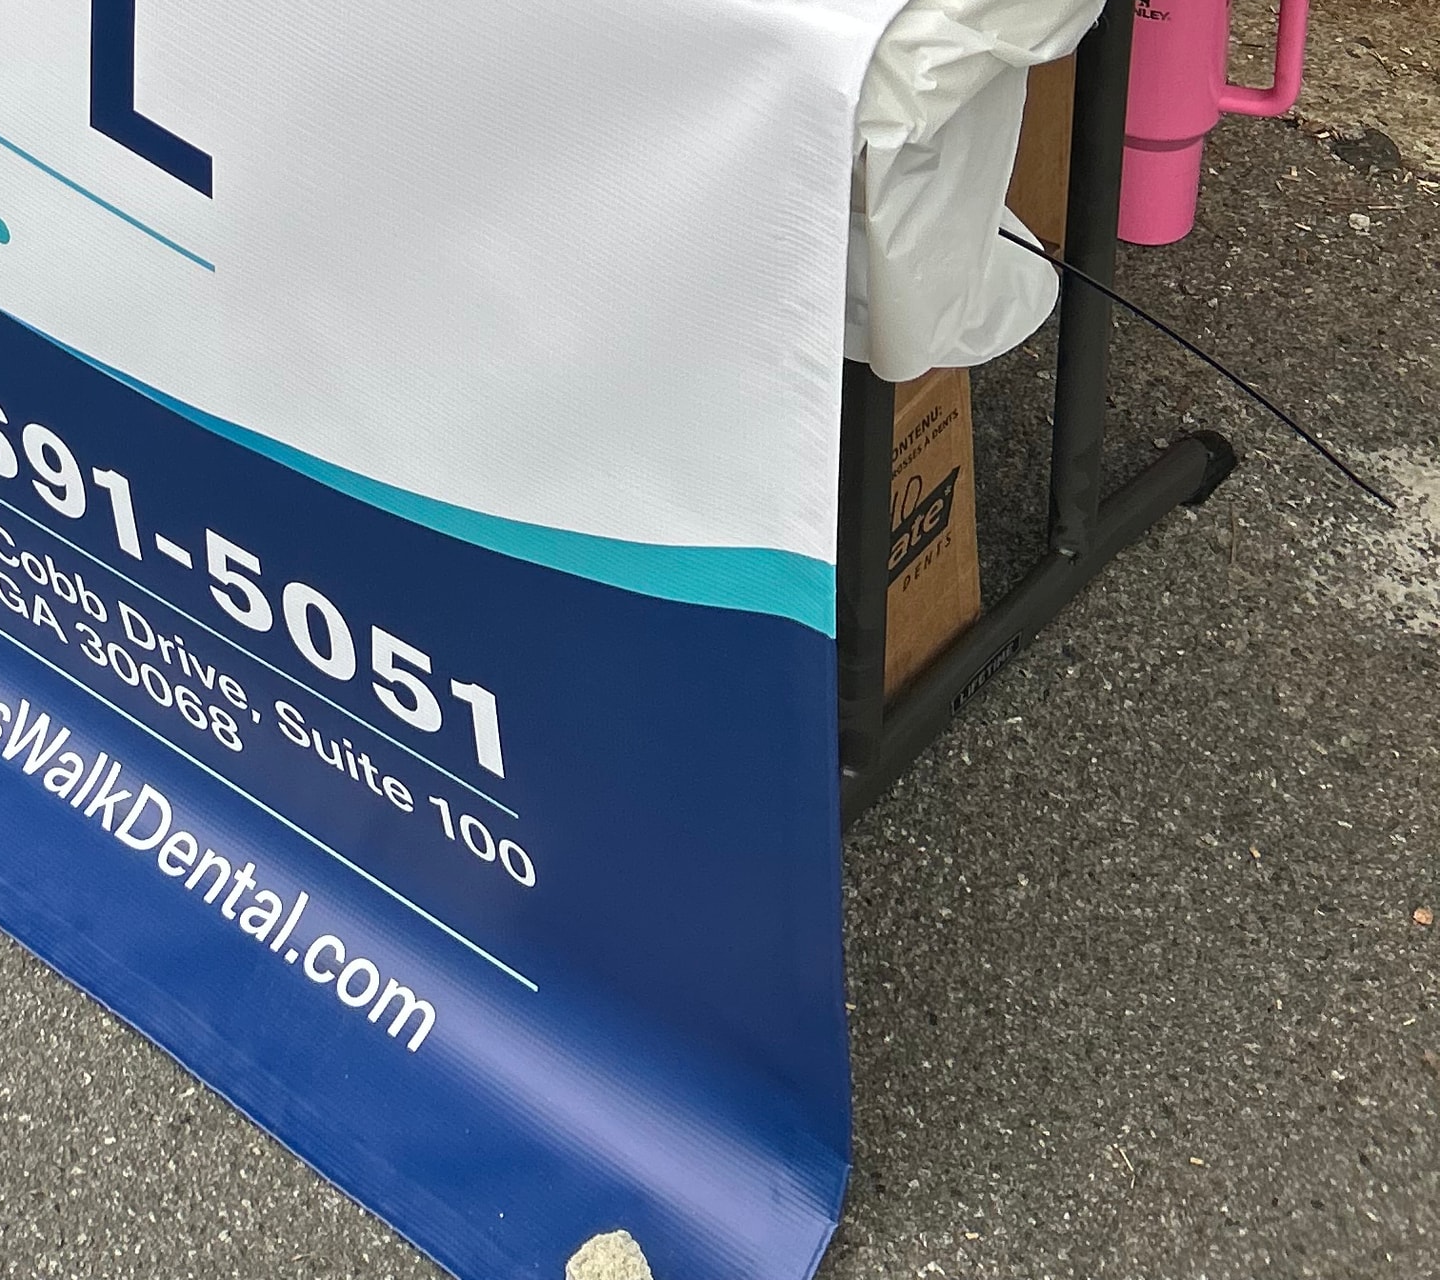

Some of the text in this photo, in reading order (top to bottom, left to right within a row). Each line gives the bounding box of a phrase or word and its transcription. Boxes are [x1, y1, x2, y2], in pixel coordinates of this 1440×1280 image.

[1135, 8, 1170, 20] NLEY
[892, 405, 943, 463] ONTENU:
[892, 444, 924, 481] ROSSES
[932, 408, 959, 441] DENTS
[901, 530, 952, 592] DENTS
[79, 620, 244, 753] 30068
[958, 642, 1014, 703] LIFETIME
[118, 600, 263, 723] Drive,
[275, 700, 413, 813] Suite
[429, 796, 536, 888] 100
